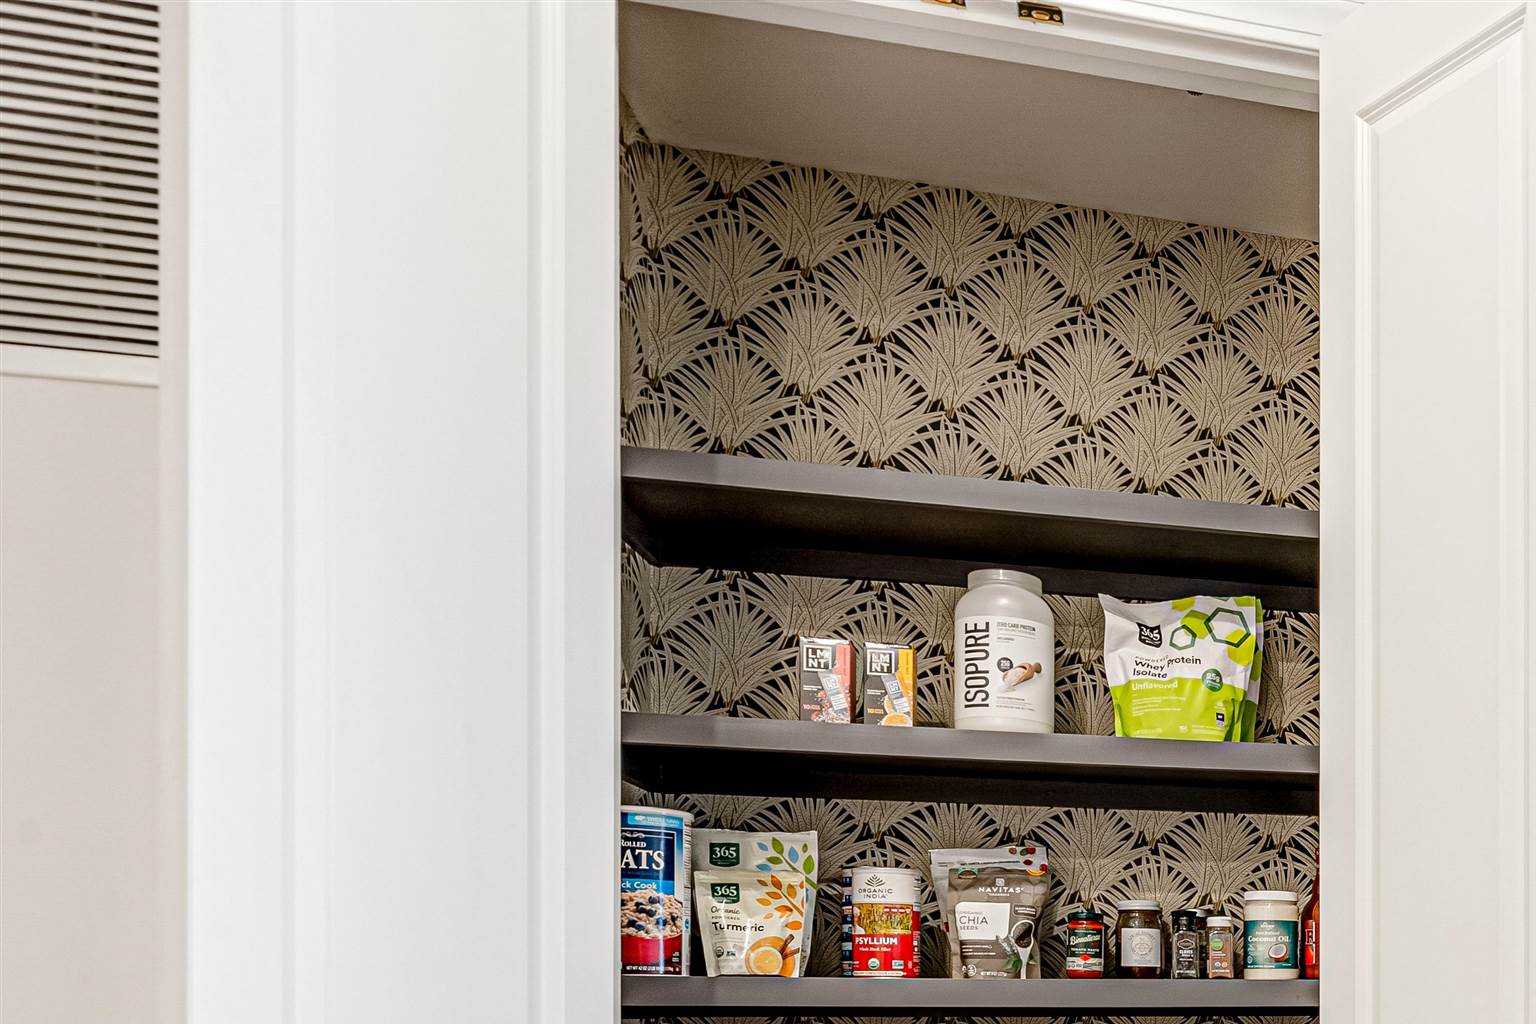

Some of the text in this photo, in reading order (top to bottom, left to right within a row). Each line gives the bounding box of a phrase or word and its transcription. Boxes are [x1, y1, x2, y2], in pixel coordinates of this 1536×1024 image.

[1140, 626, 1160, 640] 365
[808, 659, 828, 668] NT
[872, 653, 890, 663] LM
[872, 663, 890, 676] NT
[964, 622, 990, 708] ISOPURE
[1135, 660, 1166, 671] Whey
[1133, 668, 1168, 678] Isolate
[1206, 672, 1221, 683] 25g
[1132, 680, 1178, 691] Unflavored
[713, 847, 737, 859] 365
[621, 849, 665, 870] ATS
[634, 881, 657, 890] Cook
[714, 885, 738, 897] 365
[711, 906, 740, 914] Oranic
[960, 916, 989, 925] CHIA
[712, 921, 765, 932] Turmeric
[855, 937, 898, 945] PSYLLIUM
